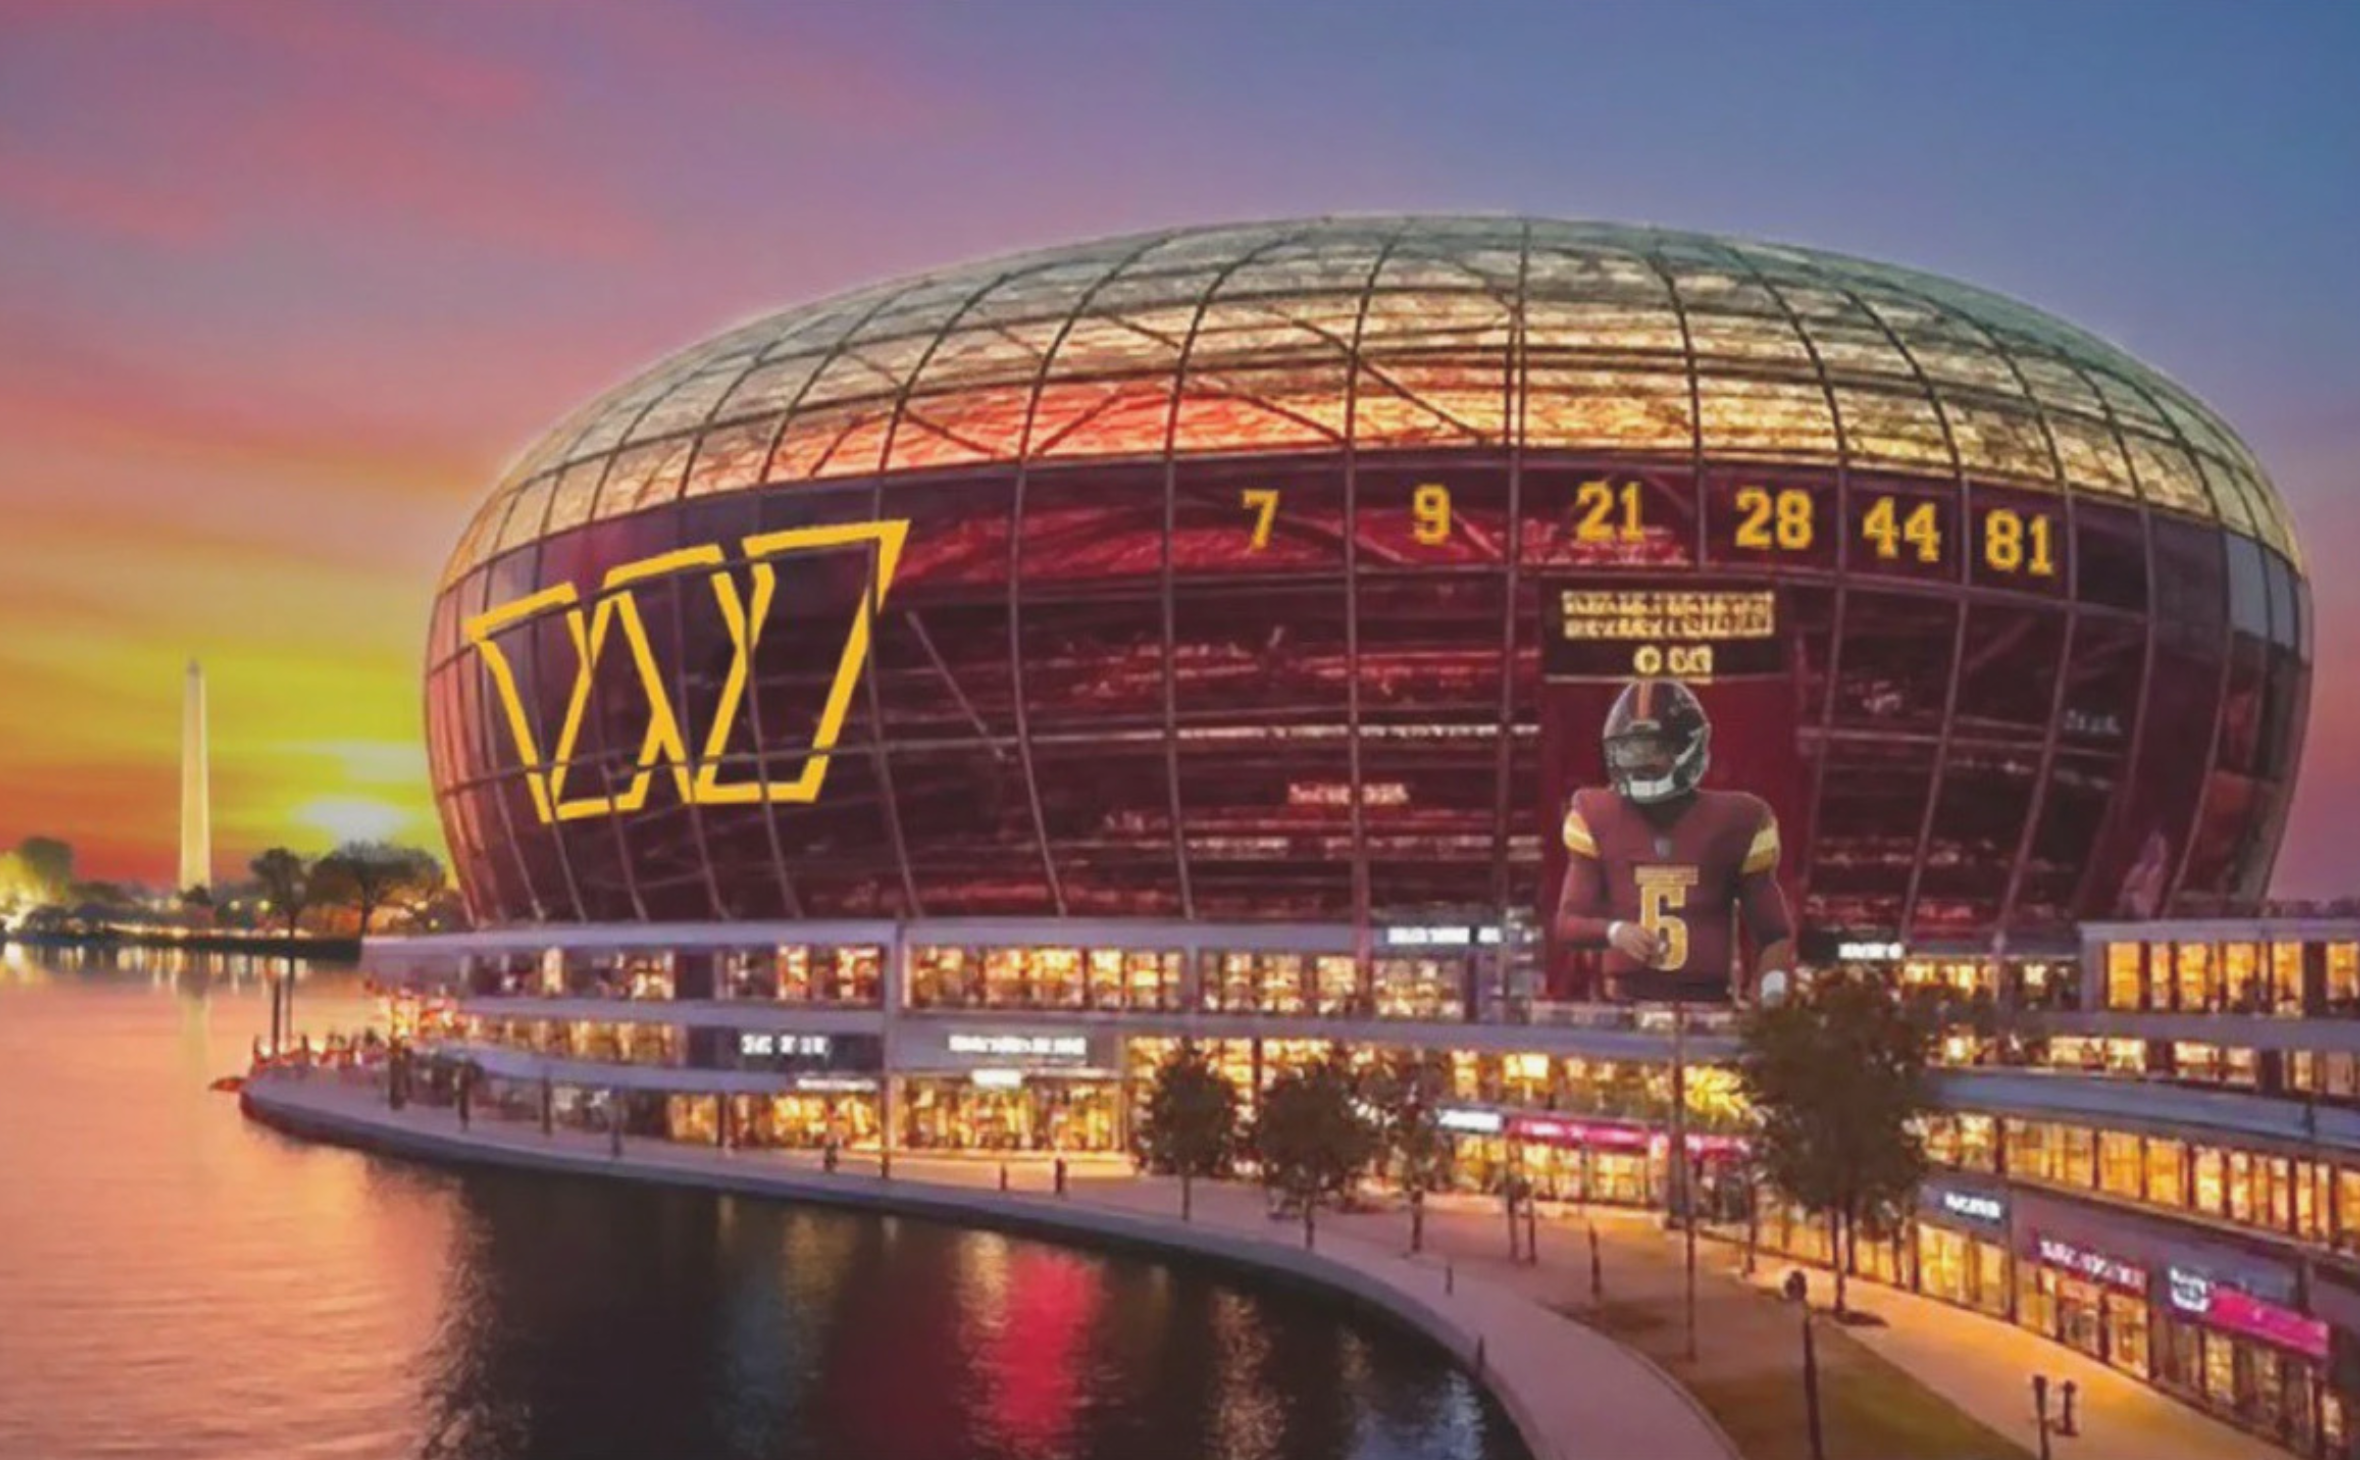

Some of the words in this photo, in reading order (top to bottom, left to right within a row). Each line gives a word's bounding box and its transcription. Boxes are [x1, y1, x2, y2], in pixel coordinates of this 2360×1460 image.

[1242, 488, 1279, 550] 7
[1413, 484, 1451, 545] 9
[1576, 481, 1645, 544] 21
[1736, 486, 1813, 550] 28
[1862, 496, 1940, 562] 44
[1985, 509, 2053, 575] 81
